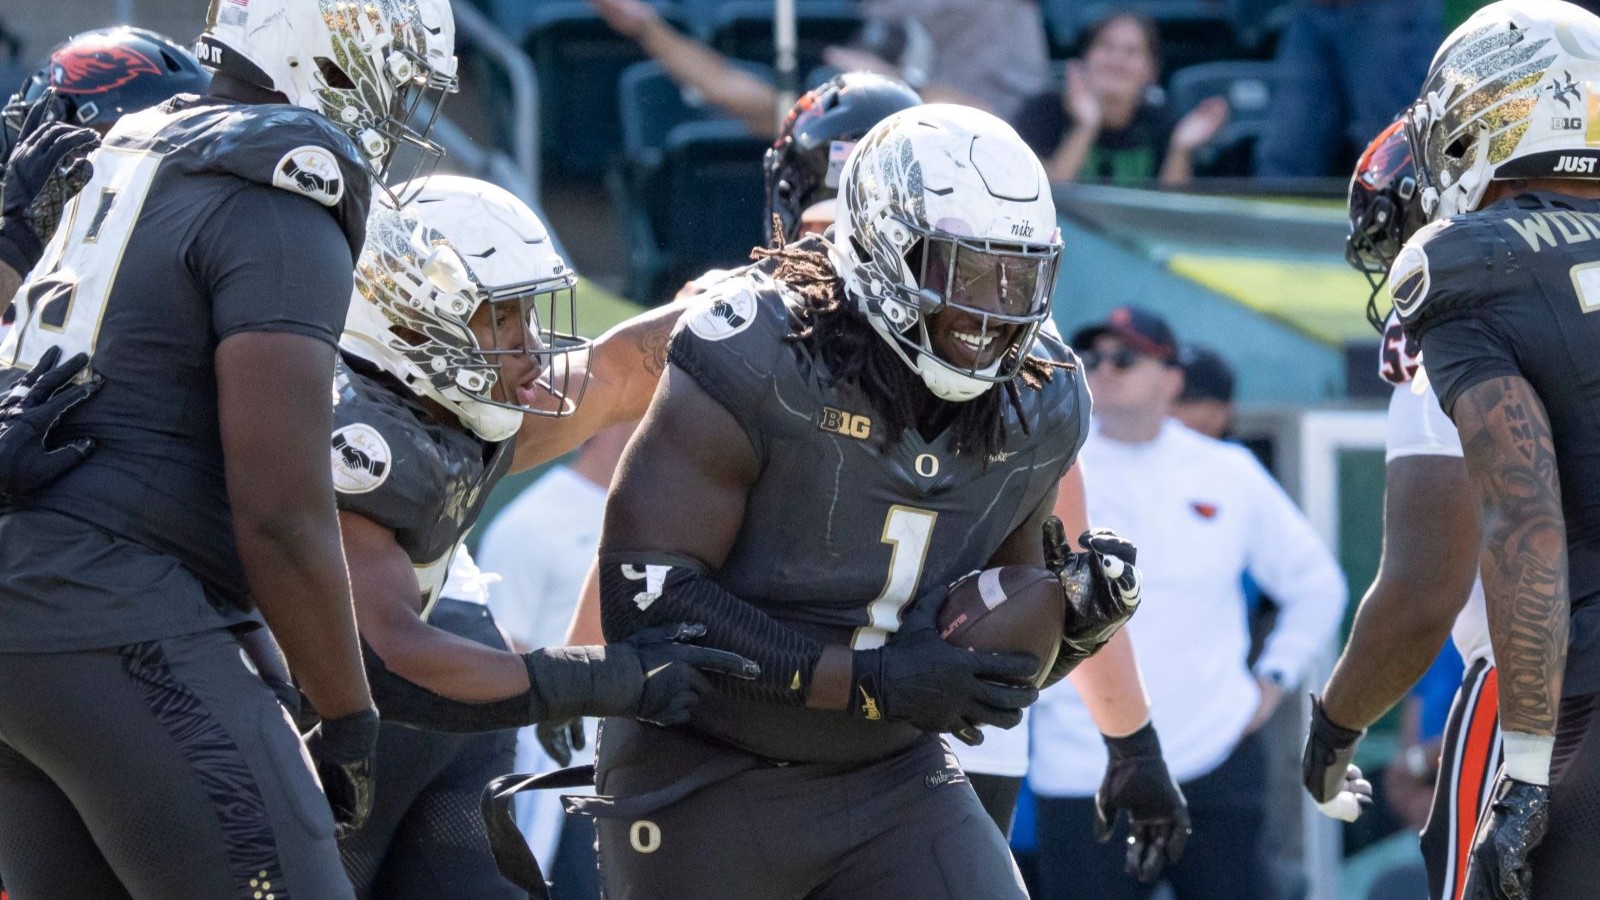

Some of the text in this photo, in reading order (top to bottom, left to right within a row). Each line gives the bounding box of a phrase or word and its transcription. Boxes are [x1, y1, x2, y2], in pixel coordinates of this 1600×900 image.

[211, 46, 223, 64] IT
[1553, 155, 1598, 173] JUST
[1011, 219, 1035, 238] nike
[914, 453, 940, 478] O
[850, 504, 939, 651] 1
[630, 820, 662, 854] O
